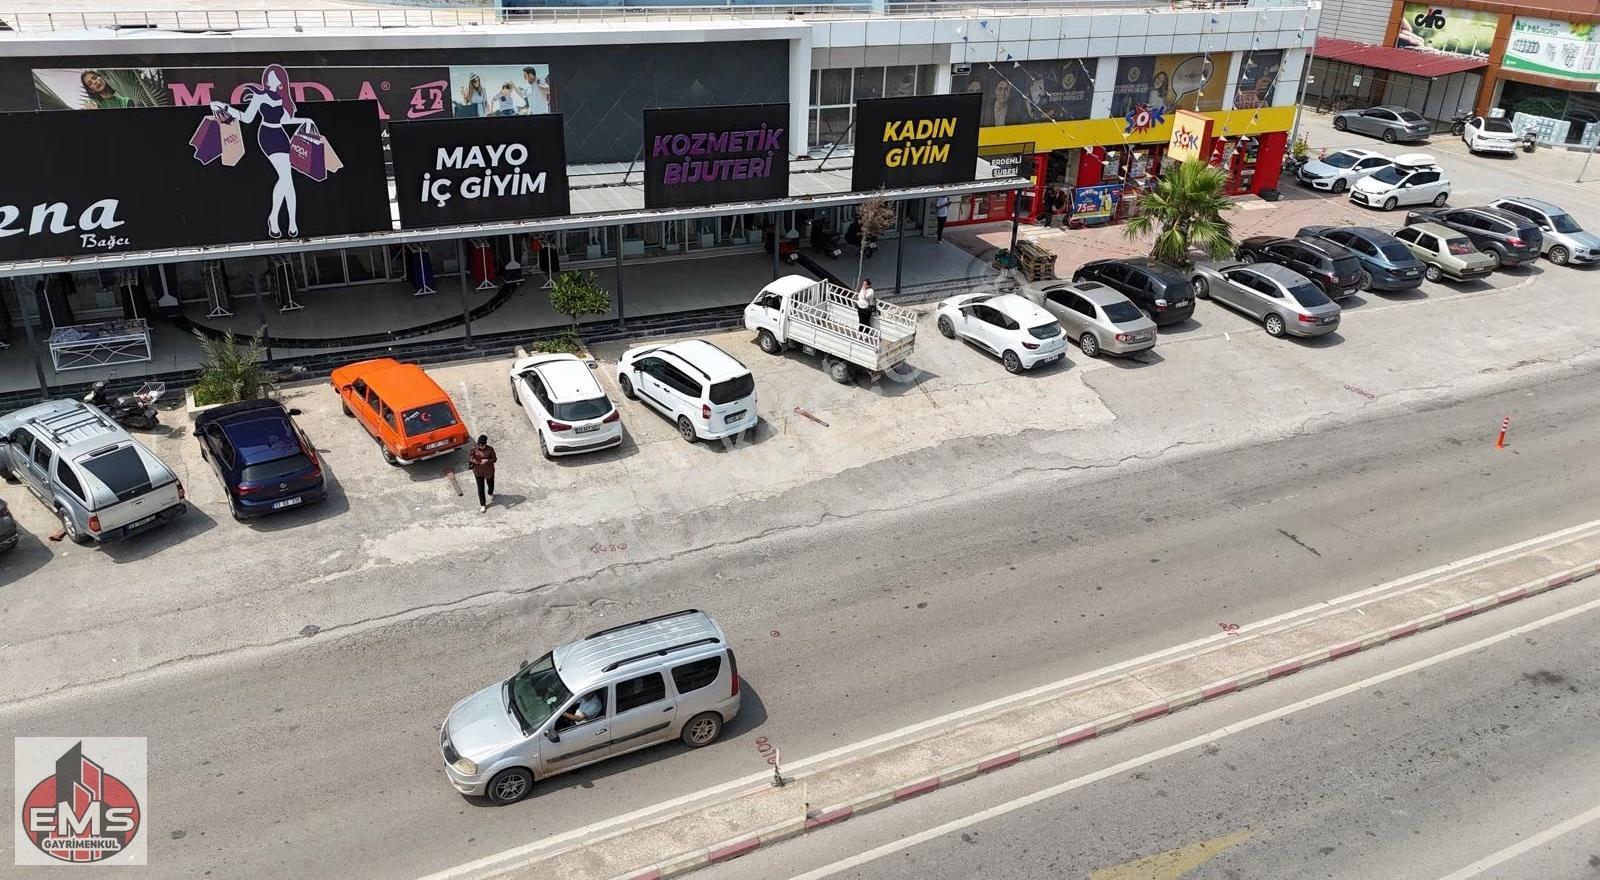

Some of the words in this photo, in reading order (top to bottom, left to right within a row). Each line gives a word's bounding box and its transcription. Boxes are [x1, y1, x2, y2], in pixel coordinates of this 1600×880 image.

[652, 123, 784, 157] KOZMETİK
[882, 117, 957, 142] KADIN
[436, 143, 528, 170] MAYO
[885, 140, 950, 168] GİYİM
[991, 155, 1022, 166] ERDEMLİ
[663, 151, 773, 185] BİJUTERİ
[421, 173, 451, 207] İÇ
[459, 167, 547, 199] GİYİM
[80, 233, 131, 249] Bağcı
